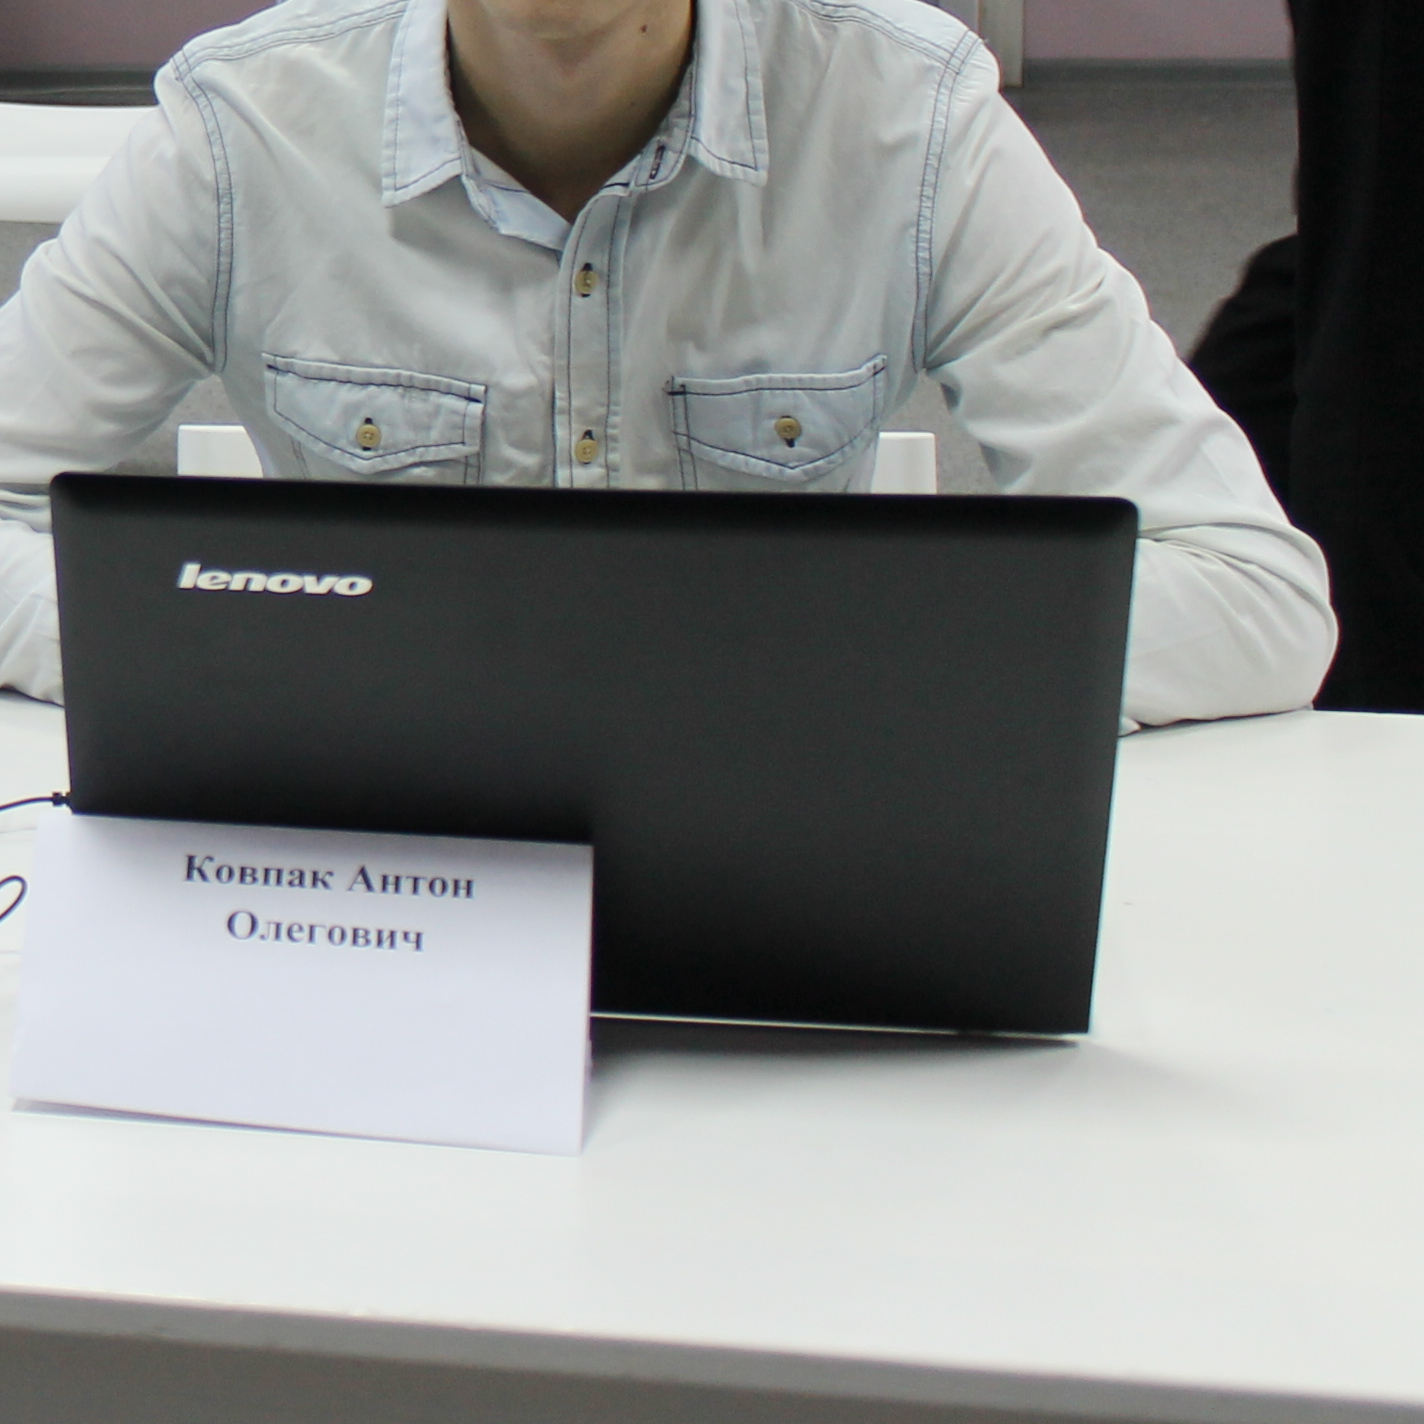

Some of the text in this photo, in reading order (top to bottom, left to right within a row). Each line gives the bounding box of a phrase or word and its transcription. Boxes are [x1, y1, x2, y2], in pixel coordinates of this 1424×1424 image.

[178, 561, 374, 597] lenovo
[184, 854, 475, 900] Ковпак Антон
[226, 909, 425, 953] Олегович
